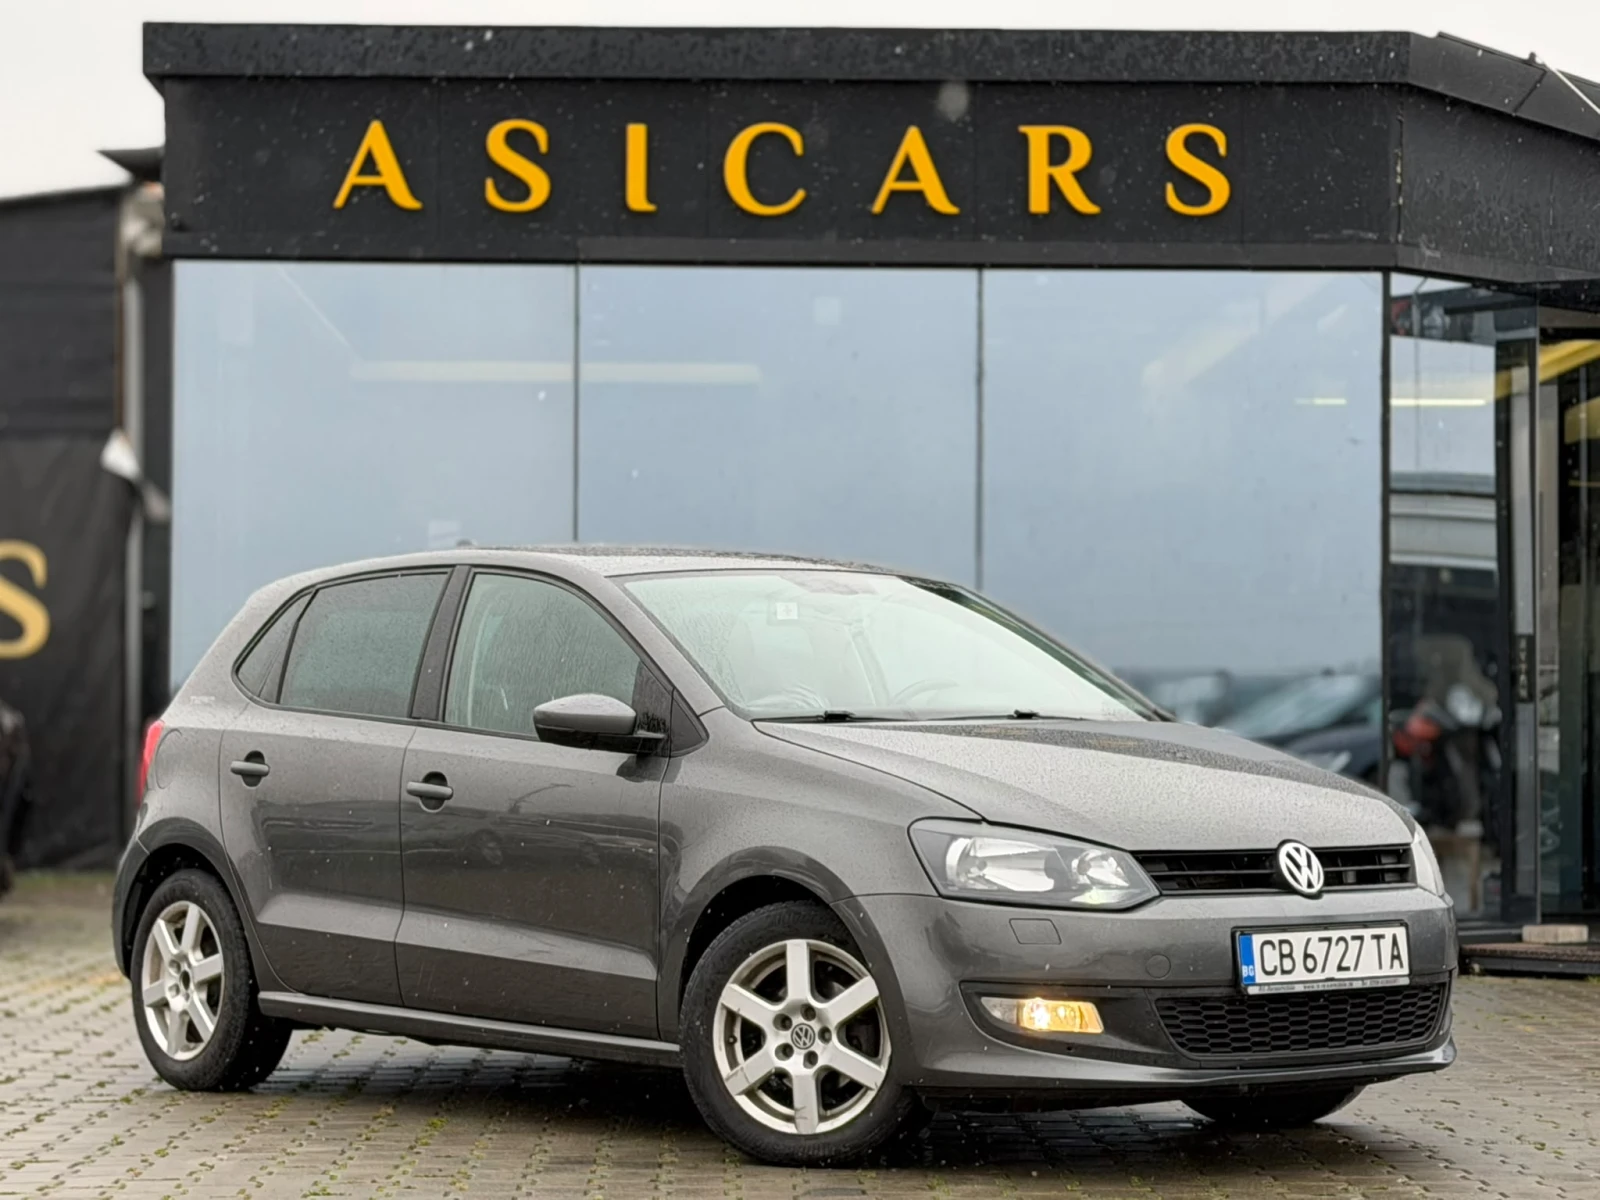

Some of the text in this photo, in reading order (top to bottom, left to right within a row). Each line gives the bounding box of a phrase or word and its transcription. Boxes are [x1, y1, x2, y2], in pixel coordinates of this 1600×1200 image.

[333, 119, 1231, 216] ASICARS
[1242, 965, 1255, 977] BG
[1260, 933, 1404, 976] CB 6727 TA
